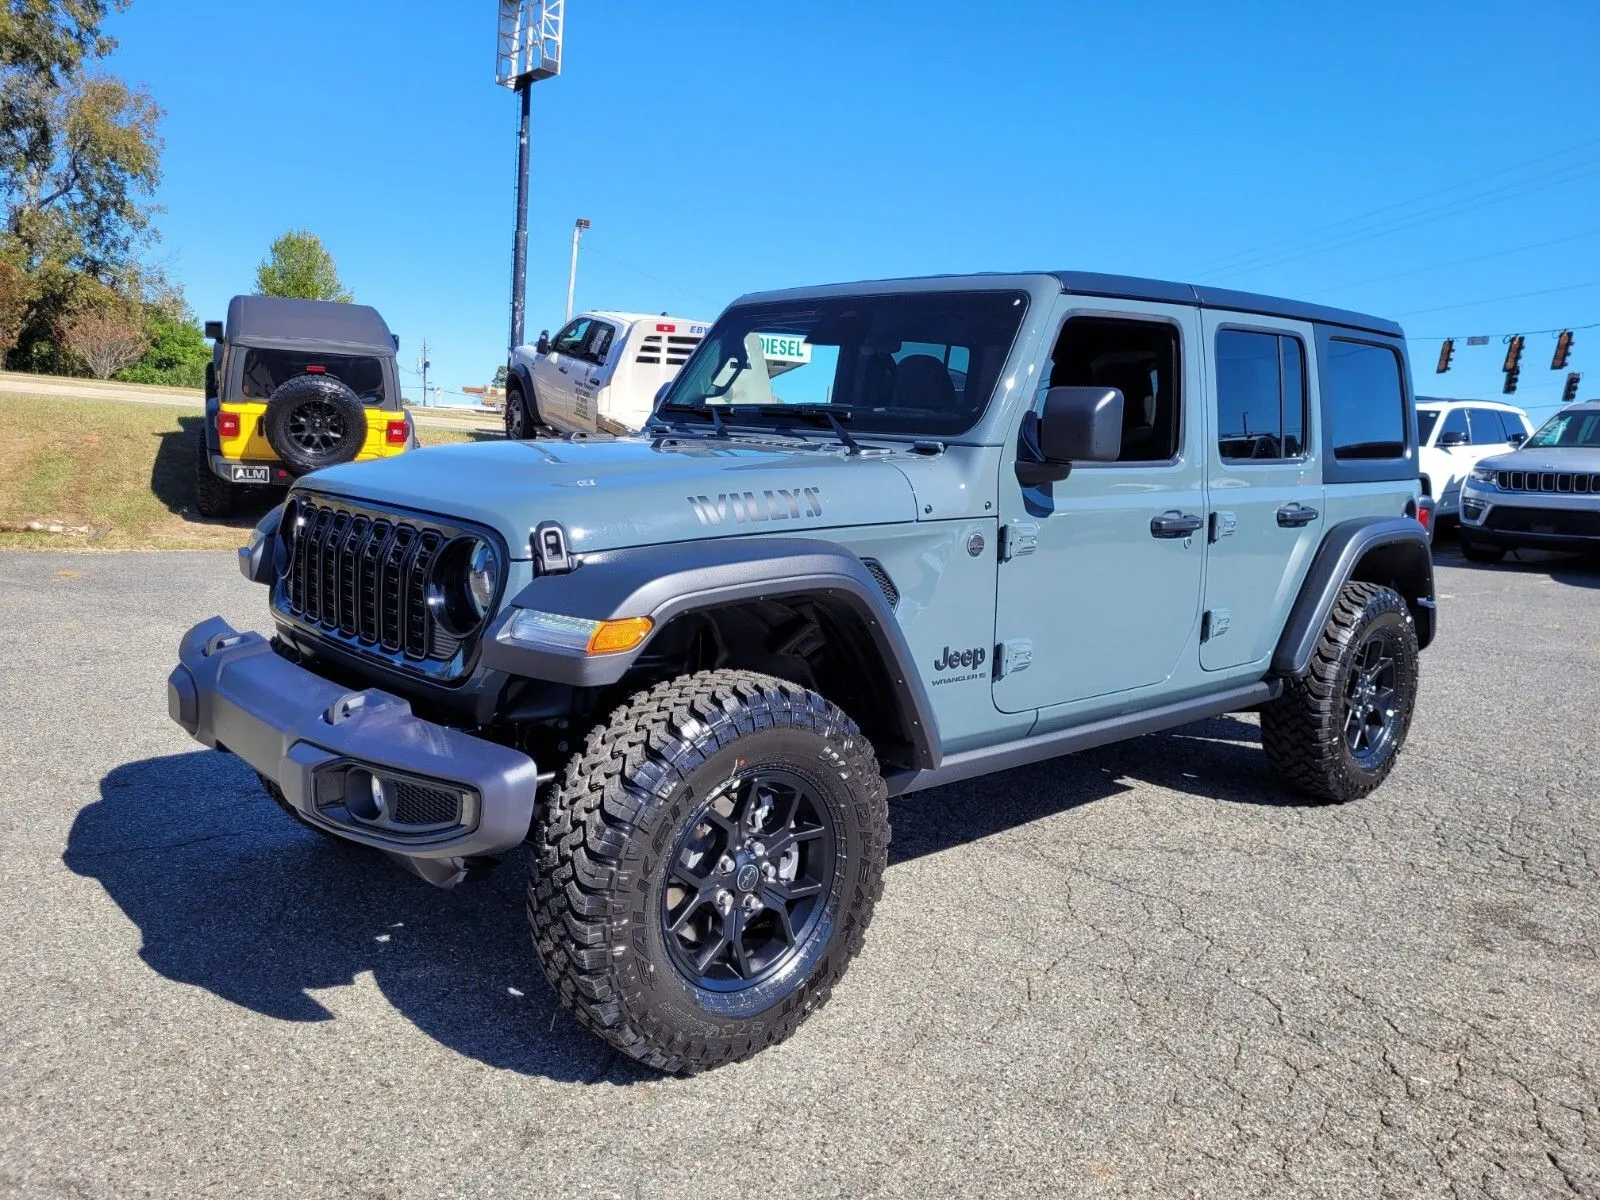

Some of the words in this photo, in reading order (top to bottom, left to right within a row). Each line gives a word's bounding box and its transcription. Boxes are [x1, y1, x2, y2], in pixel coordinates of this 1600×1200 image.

[235, 468, 265, 478] ALM
[687, 487, 822, 526] WILLYS
[934, 645, 986, 671] Jeep
[931, 674, 978, 686] WRANGLER
